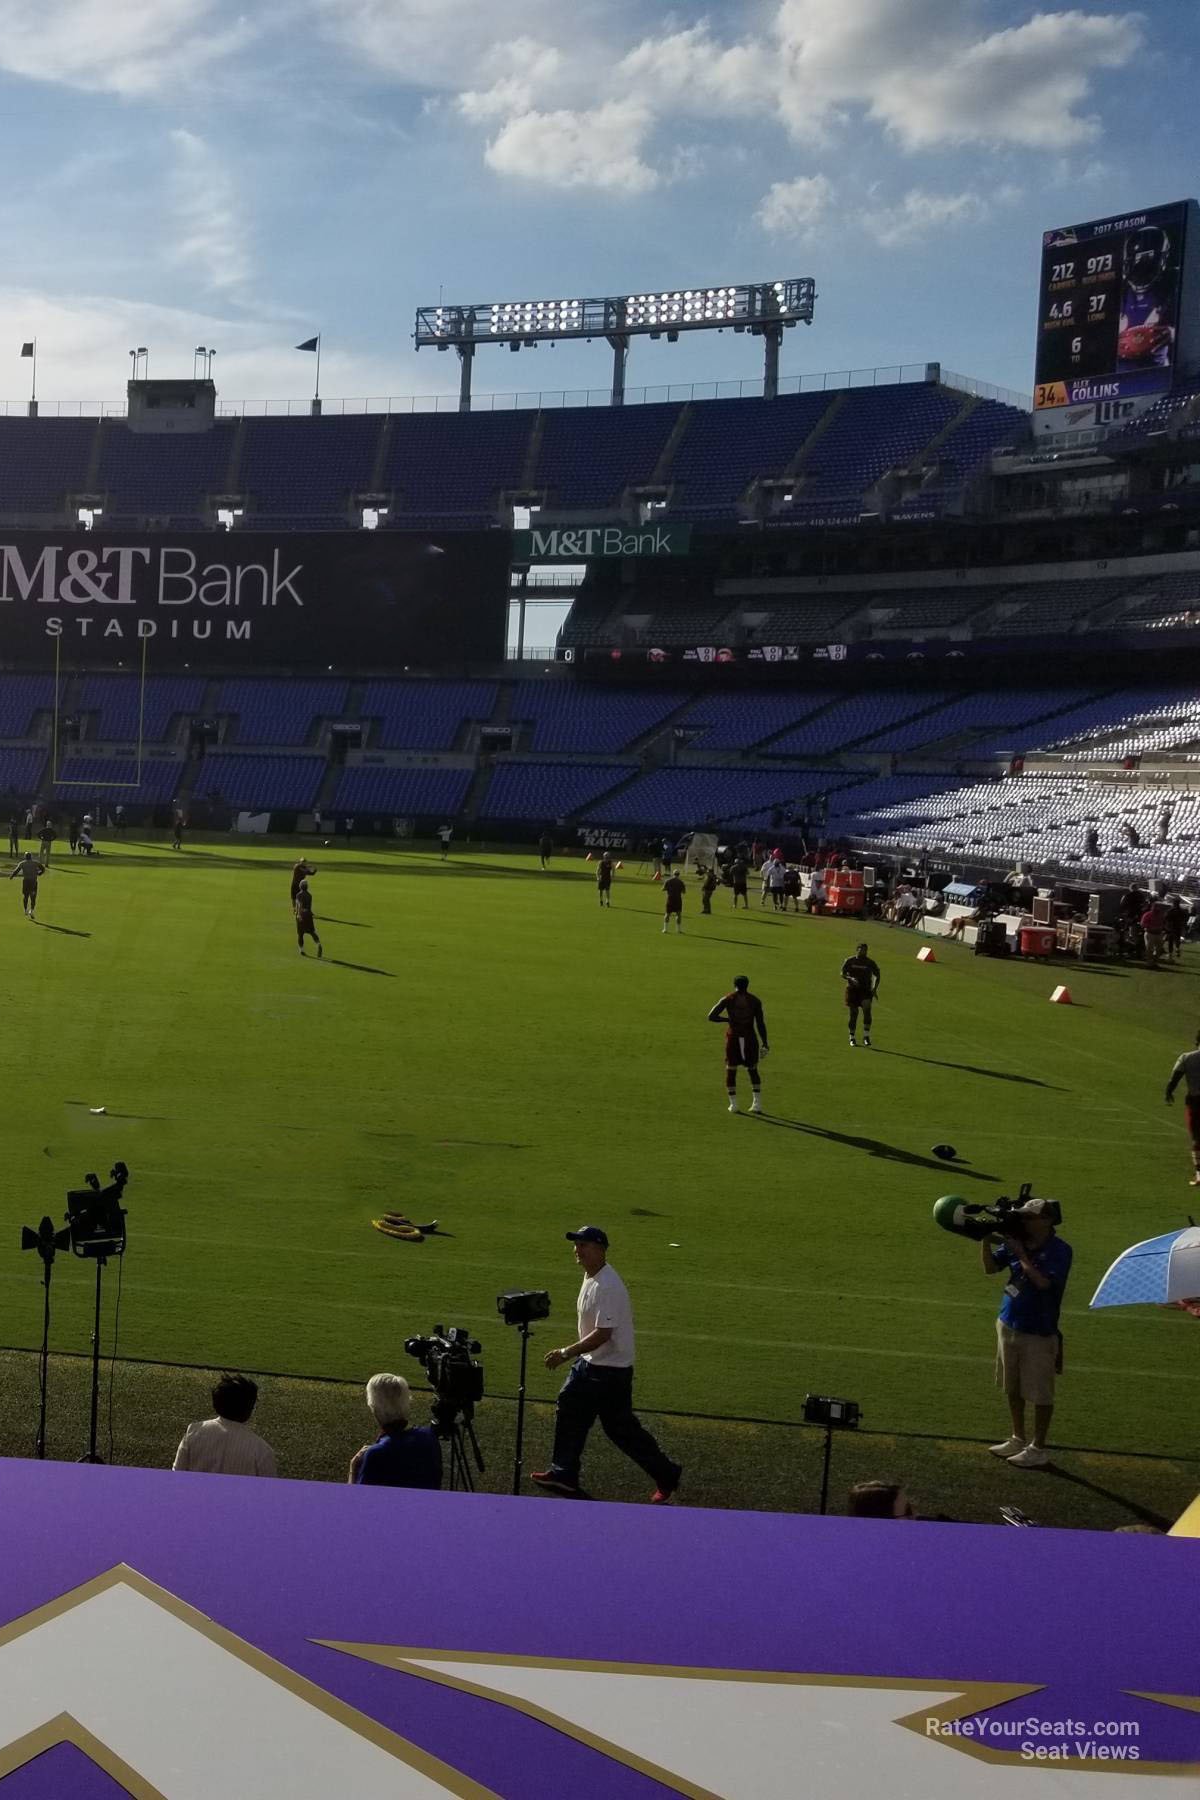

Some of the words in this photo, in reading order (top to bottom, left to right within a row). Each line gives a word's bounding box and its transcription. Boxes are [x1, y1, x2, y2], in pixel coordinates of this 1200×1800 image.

[1093, 222, 1112, 236] 2017
[1114, 215, 1146, 231] SEASON
[1052, 262, 1074, 281] 212
[1087, 254, 1112, 273] 973
[1050, 300, 1072, 320] 4.6
[1089, 294, 1106, 312] 37
[1072, 336, 1082, 353] 6
[1038, 386, 1056, 406] 34
[1072, 383, 1120, 401] COLLINS
[530, 530, 600, 556] M&T
[602, 528, 671, 555] Bank
[158, 548, 304, 606] Bank
[45, 617, 250, 640] STADIUM
